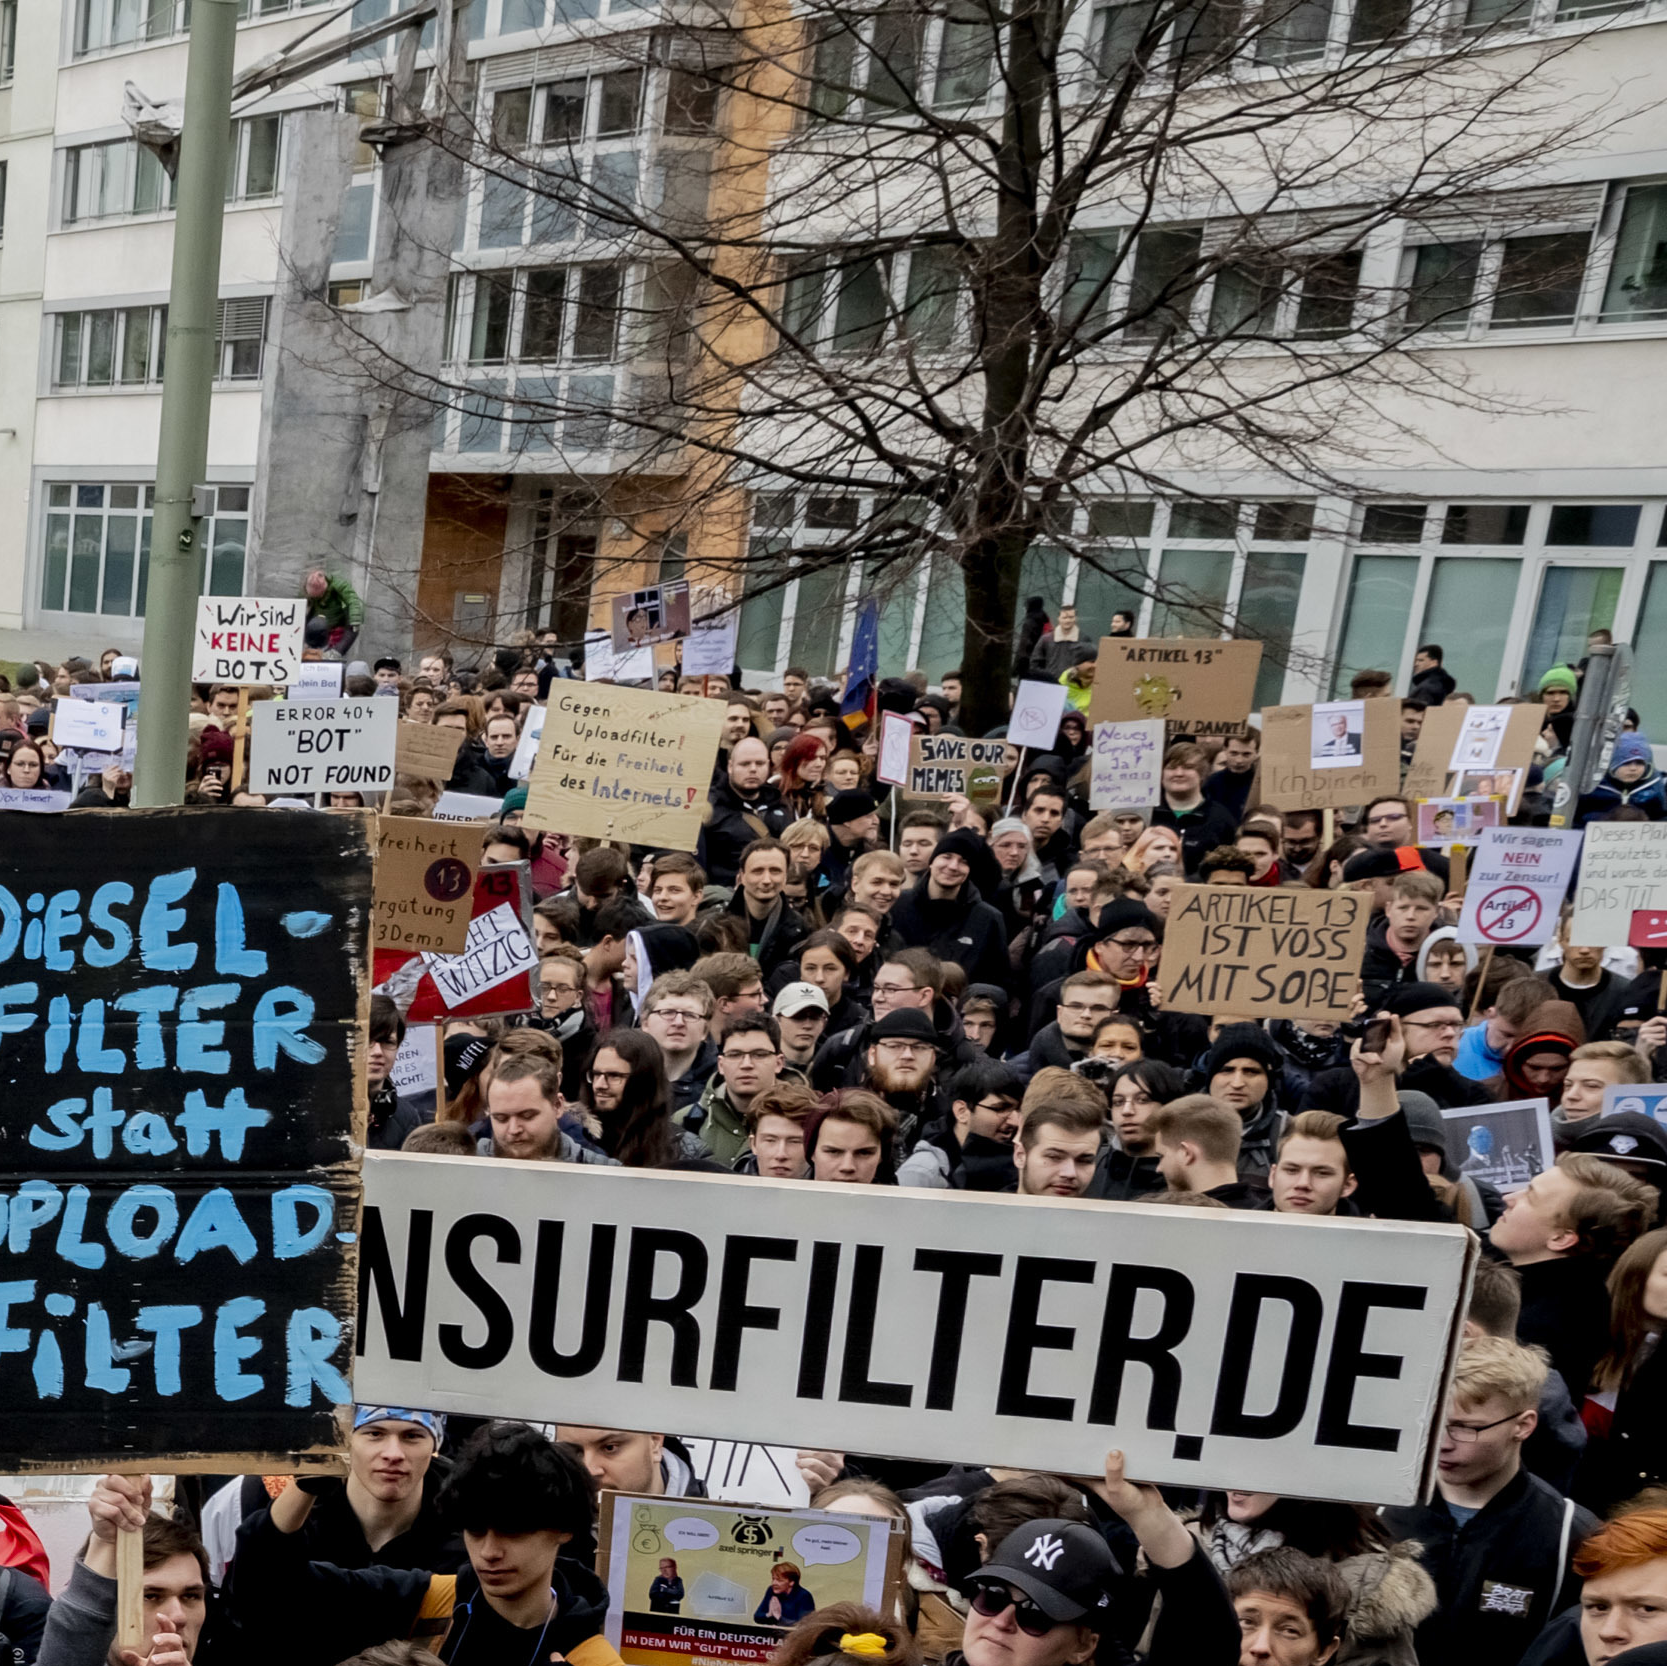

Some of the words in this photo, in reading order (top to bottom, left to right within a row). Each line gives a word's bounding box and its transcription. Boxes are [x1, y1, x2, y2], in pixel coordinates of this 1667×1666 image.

[217, 601, 257, 627] Wir
[259, 603, 296, 628] sind
[211, 632, 282, 654] KEINE
[215, 658, 289, 682] BOTS
[320, 679, 338, 689] Bot
[275, 707, 335, 722] ERROR
[343, 705, 375, 720] 404
[560, 696, 612, 718] Gegen
[572, 721, 686, 751] Uploadfilter!
[1195, 719, 1247, 736] DANKE!
[552, 745, 578, 764] Für
[585, 752, 608, 768] die
[616, 753, 685, 778] Freiheit
[920, 736, 967, 764] SAVE
[970, 742, 1004, 764] OUR
[266, 764, 314, 786] NOT
[324, 764, 392, 785] FOUND
[911, 766, 965, 794] MEMES
[1271, 764, 1307, 792] Ich
[559, 773, 587, 791] des
[591, 776, 698, 810] Internets!
[1490, 833, 1517, 846] Wir
[1520, 835, 1563, 850] sagen
[1590, 826, 1636, 843] Dieses
[1502, 851, 1542, 866] NEIN
[436, 867, 462, 893] 13
[480, 872, 514, 896] 13
[1478, 870, 1500, 883] zur
[1503, 869, 1560, 884] Zensur!
[1177, 893, 1311, 926] ARTIKEL
[1316, 897, 1359, 928] 13
[1484, 898, 1533, 914] Artikel
[1579, 886, 1620, 911] DAS
[1498, 917, 1515, 931] 13
[1201, 925, 1261, 956] IST
[1271, 927, 1352, 959] VOSS
[1168, 962, 1249, 1003] MIT
[455, 1038, 490, 1072] WAFFEL
[28, 1086, 273, 1162] statt
[357, 1204, 1427, 1461] NSURFILTER.DE
[718, 1543, 737, 1552] axel
[673, 1625, 695, 1639] FÜR
[698, 1628, 716, 1640] EIN
[625, 1634, 635, 1644] IN
[636, 1635, 666, 1648] DEM
[669, 1638, 691, 1651] WIR
[731, 1645, 758, 1659] UND
